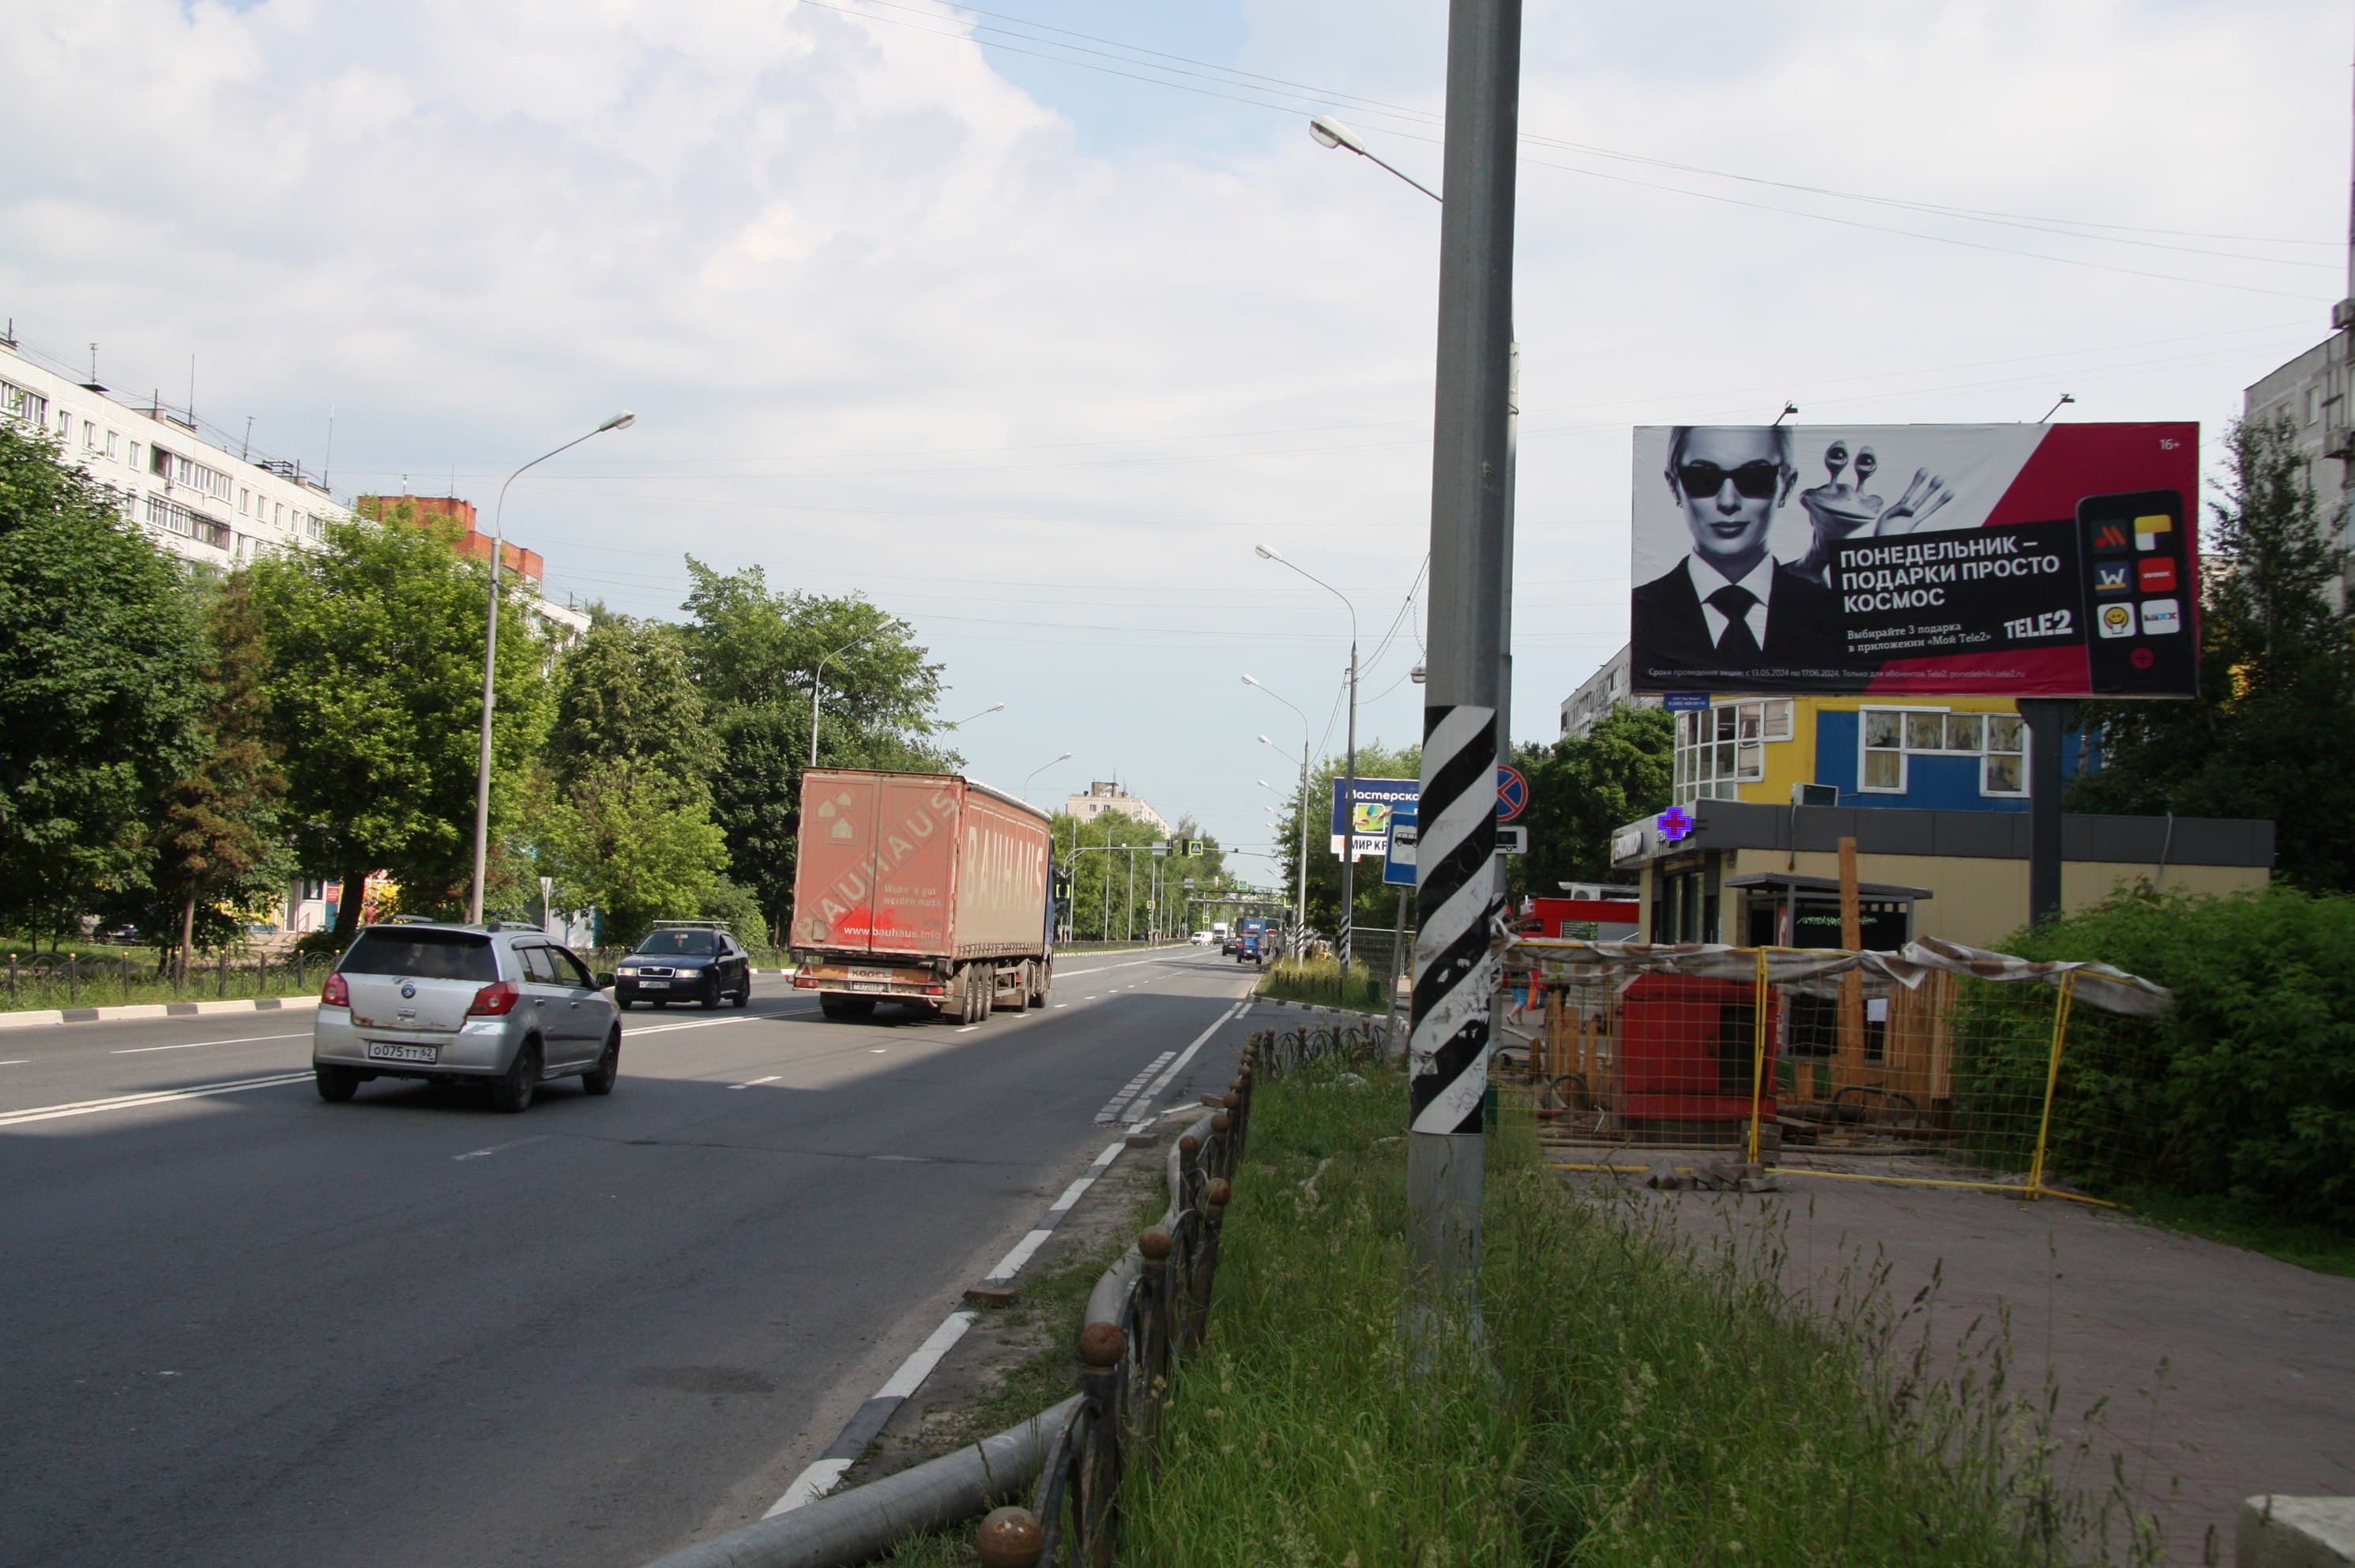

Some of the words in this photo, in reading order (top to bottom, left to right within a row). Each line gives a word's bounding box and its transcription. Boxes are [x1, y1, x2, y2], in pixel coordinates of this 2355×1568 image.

[2159, 438, 2180, 450] 16+
[1840, 536, 2018, 568] ПОНЕДЕЛЬНИК
[1842, 564, 1957, 591] ПОДАРКИ
[1962, 555, 2060, 581] ПРОСТО
[1844, 588, 1945, 613] КОСМОС
[1847, 628, 1906, 641] Выбирайте
[1908, 625, 1915, 634] 3
[1917, 622, 1962, 636] подарка
[2003, 609, 2073, 639] TELE2
[1857, 639, 1925, 653] приложении
[1928, 635, 1957, 646] «Мой
[1958, 632, 1992, 644] Tele2»
[1649, 668, 1672, 677] Сроки
[965, 825, 1044, 912] BAUHAUS
